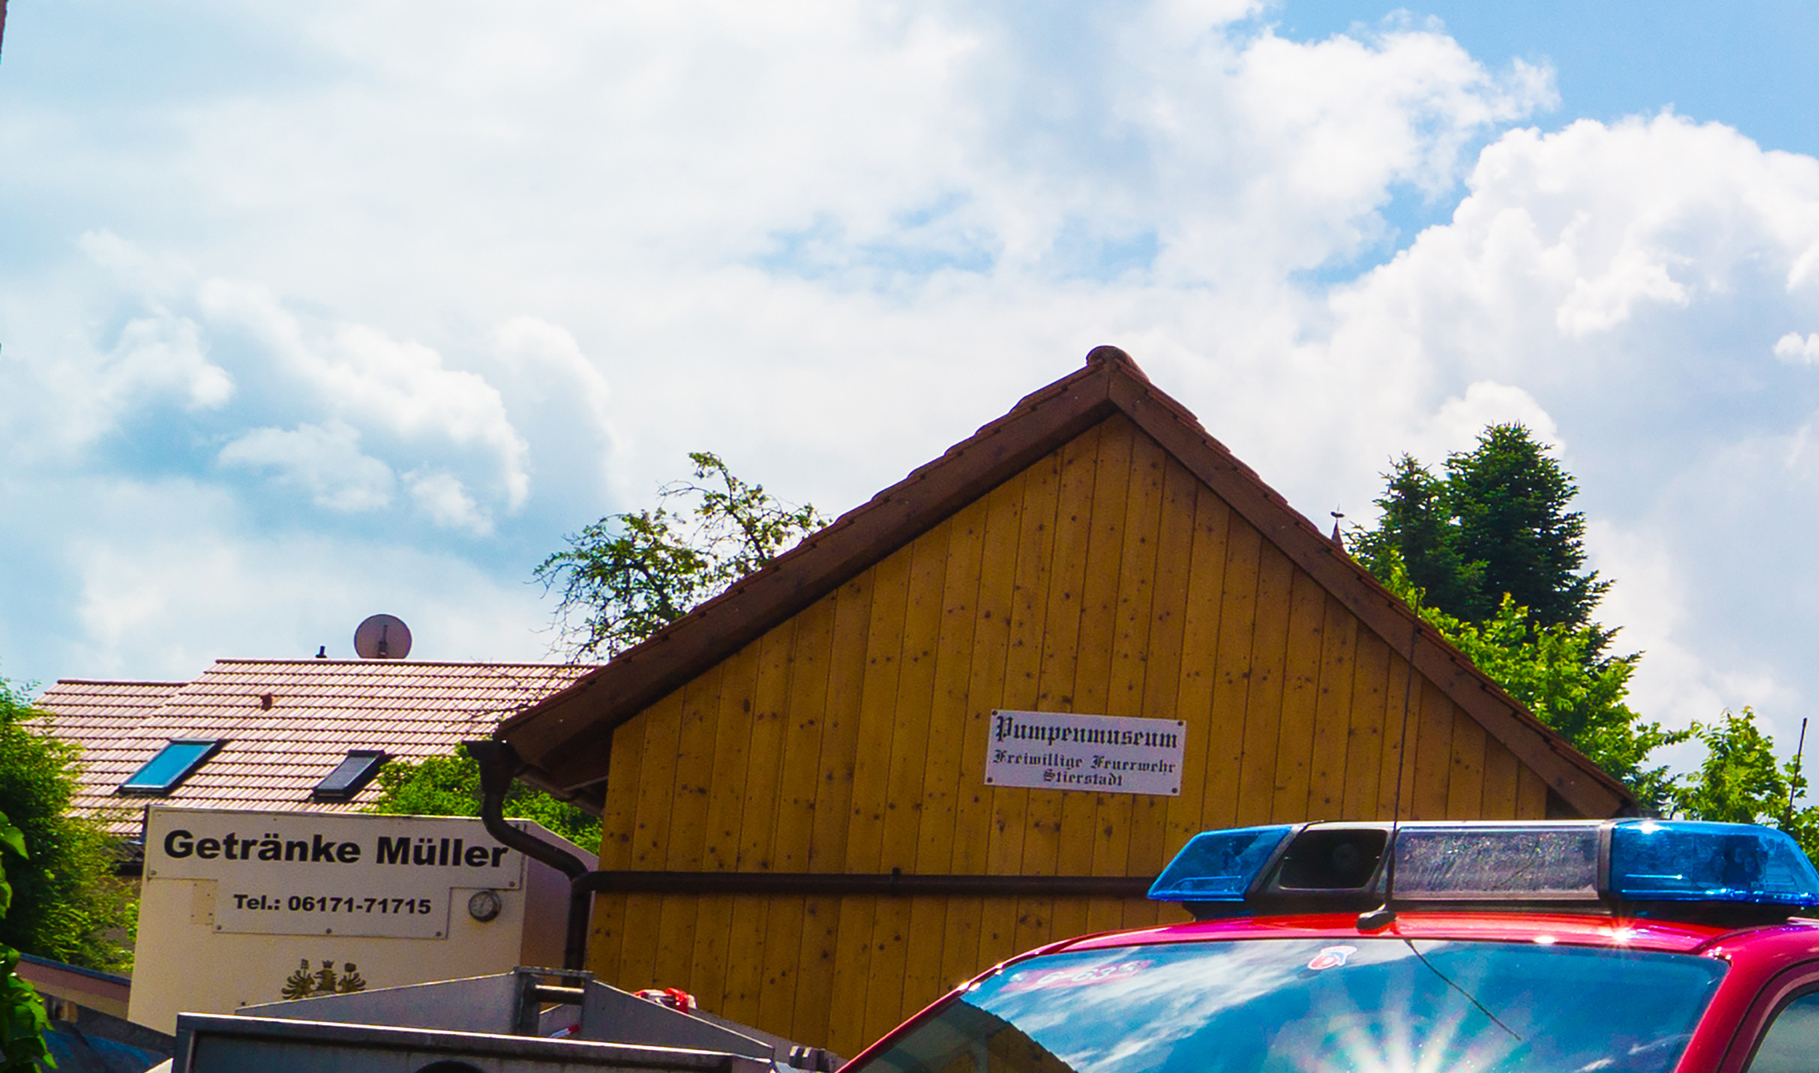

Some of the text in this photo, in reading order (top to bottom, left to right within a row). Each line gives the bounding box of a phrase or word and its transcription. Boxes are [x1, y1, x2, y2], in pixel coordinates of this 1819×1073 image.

[995, 715, 1178, 749] Pumpenmuseum
[992, 749, 1176, 775] Freiwillige Feuerwehr
[1043, 768, 1123, 787] Stierstadt
[163, 829, 509, 867] Getränke Müller
[233, 893, 432, 914] Tel.: 06171-71715
